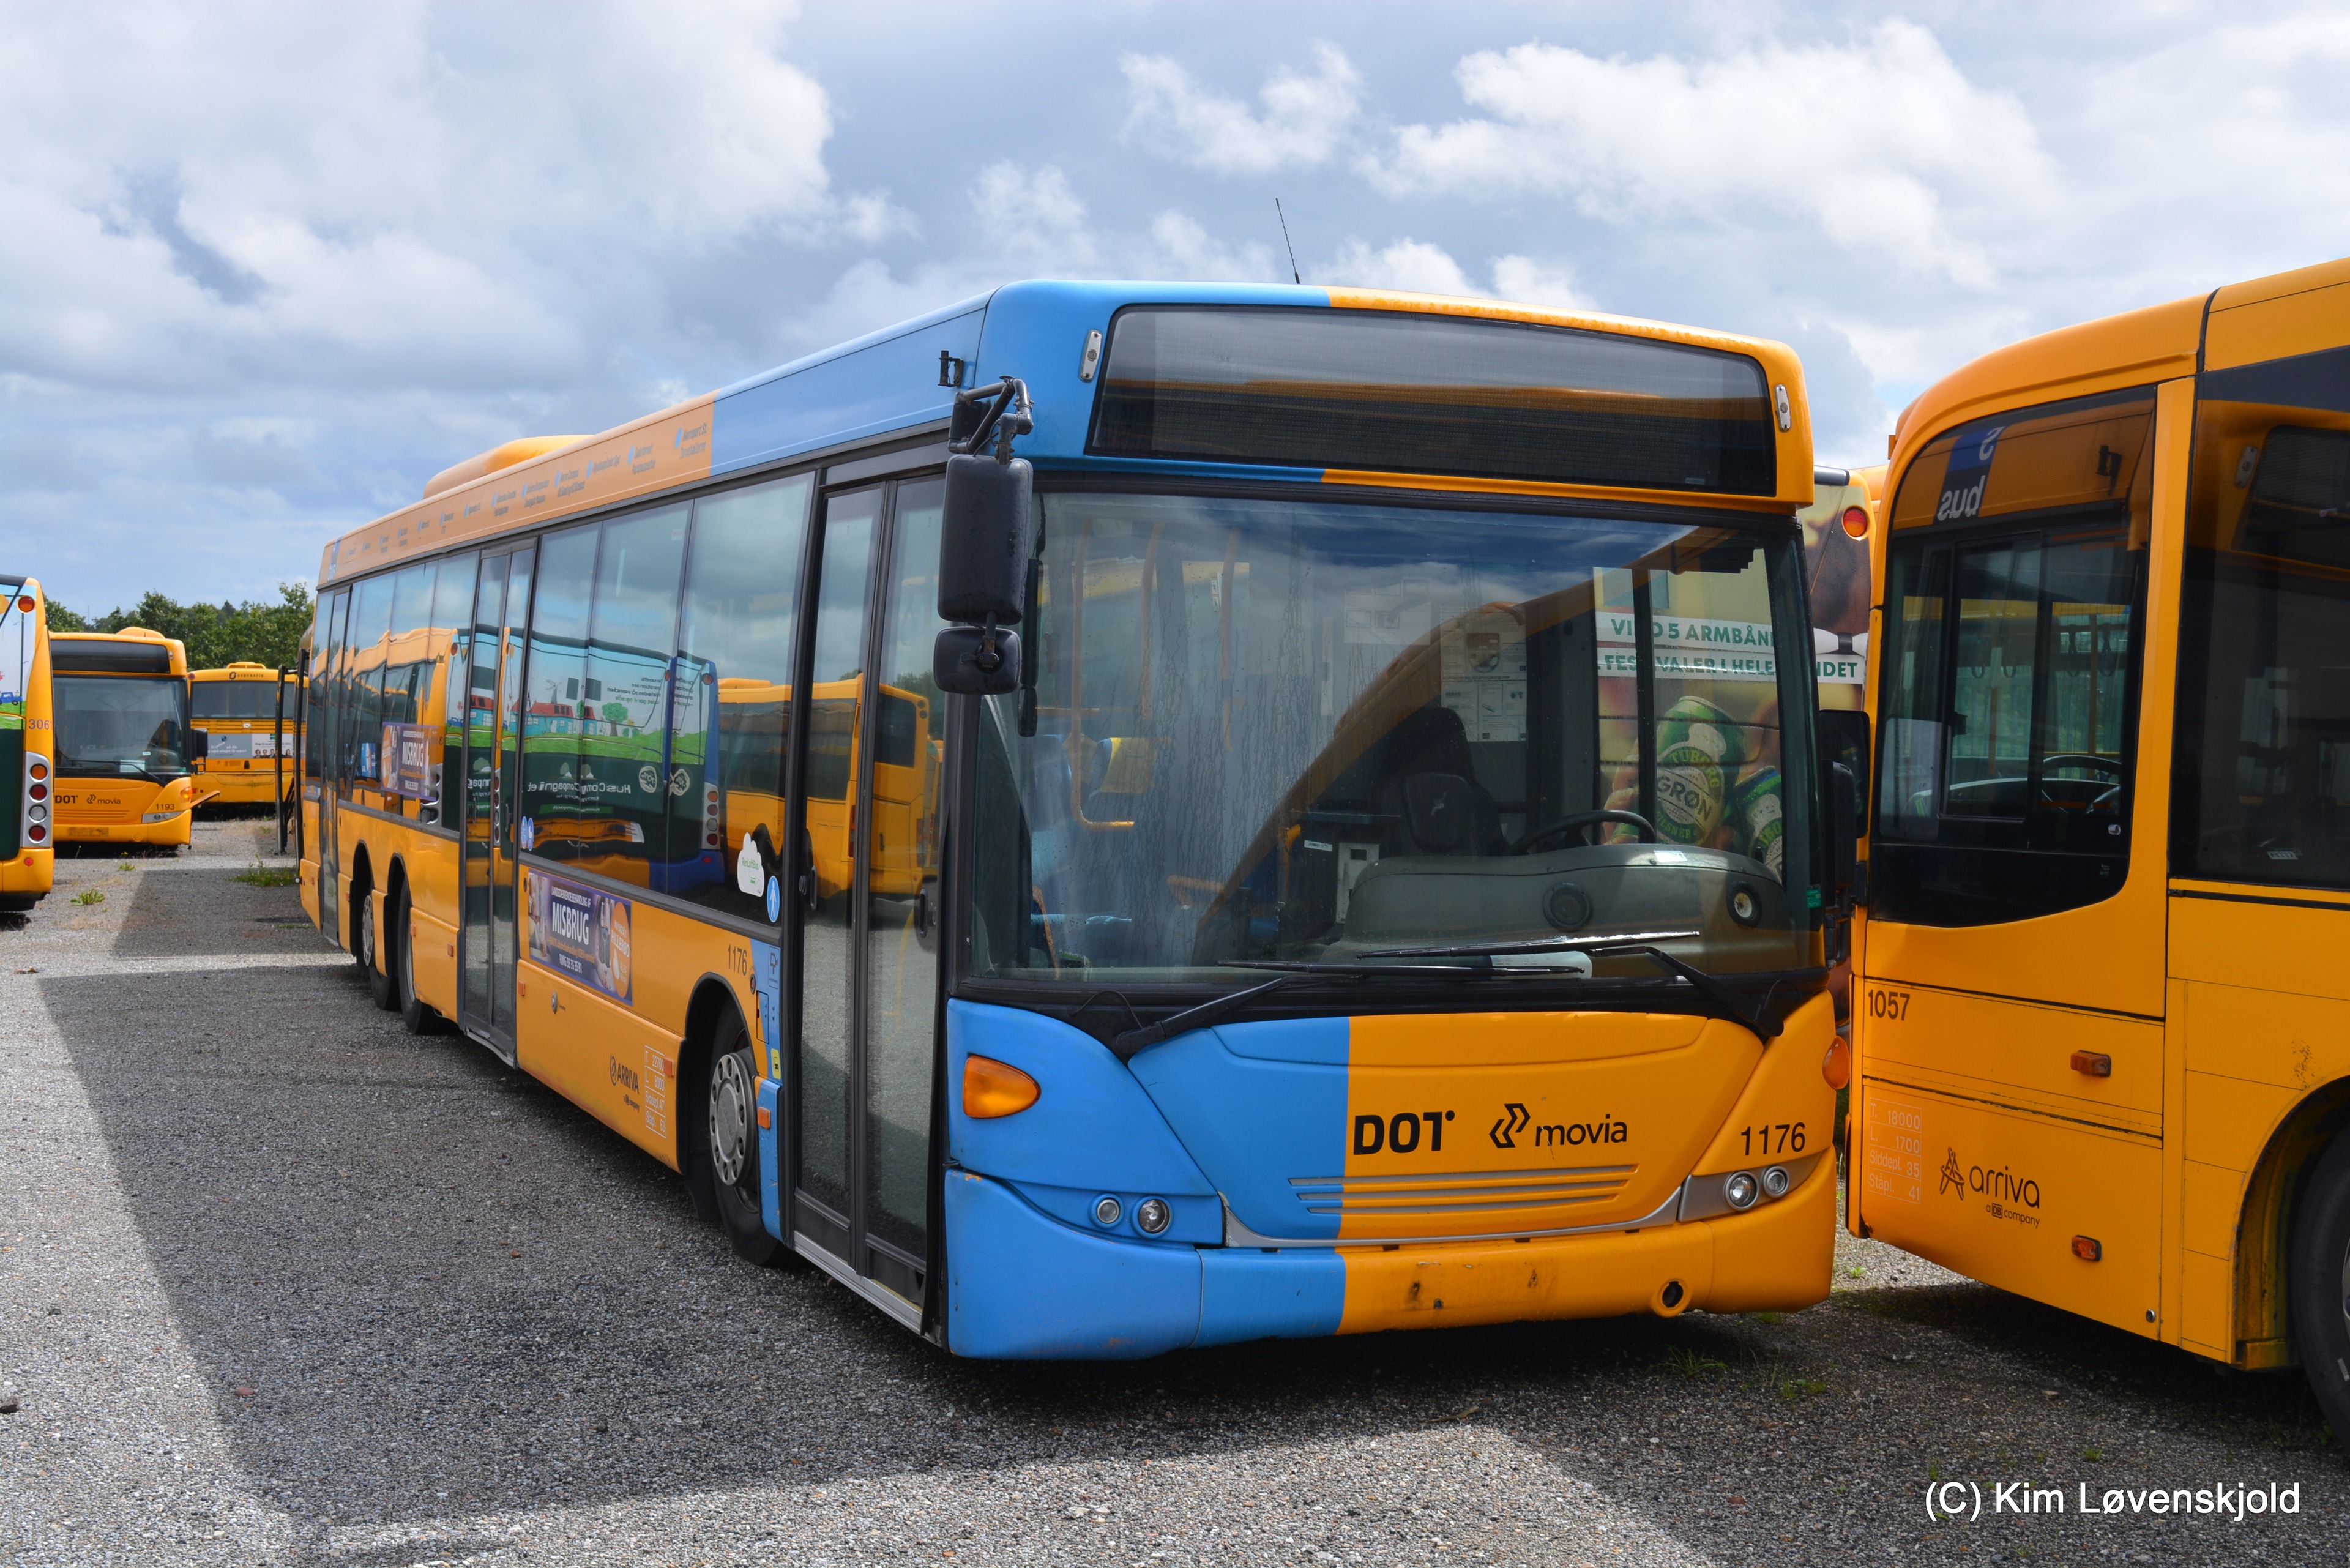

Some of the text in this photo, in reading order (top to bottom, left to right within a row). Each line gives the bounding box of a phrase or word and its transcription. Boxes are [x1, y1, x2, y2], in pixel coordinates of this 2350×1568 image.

[1611, 619, 1775, 648] VID 5 ARMBÅN
[1605, 655, 1717, 674] FESVALER
[1731, 659, 1775, 676] HELE
[1657, 775, 1712, 822] GRØN
[552, 902, 589, 946] MISBRUG
[728, 944, 747, 976] 1176
[1868, 989, 1910, 1021] 1057
[617, 1063, 639, 1095] ARRIVA
[1353, 1110, 1627, 1155] DOT movia
[1887, 1110, 1921, 1130] 18000
[1740, 1122, 1805, 1156] 1176
[1895, 1135, 1921, 1154] 1700
[1869, 1149, 1920, 1178] Siddepl. 35
[1869, 1173, 1920, 1201] Ståpl. 41
[1969, 1165, 2040, 1210] arriva
[1986, 1203, 2040, 1229] a DB company
